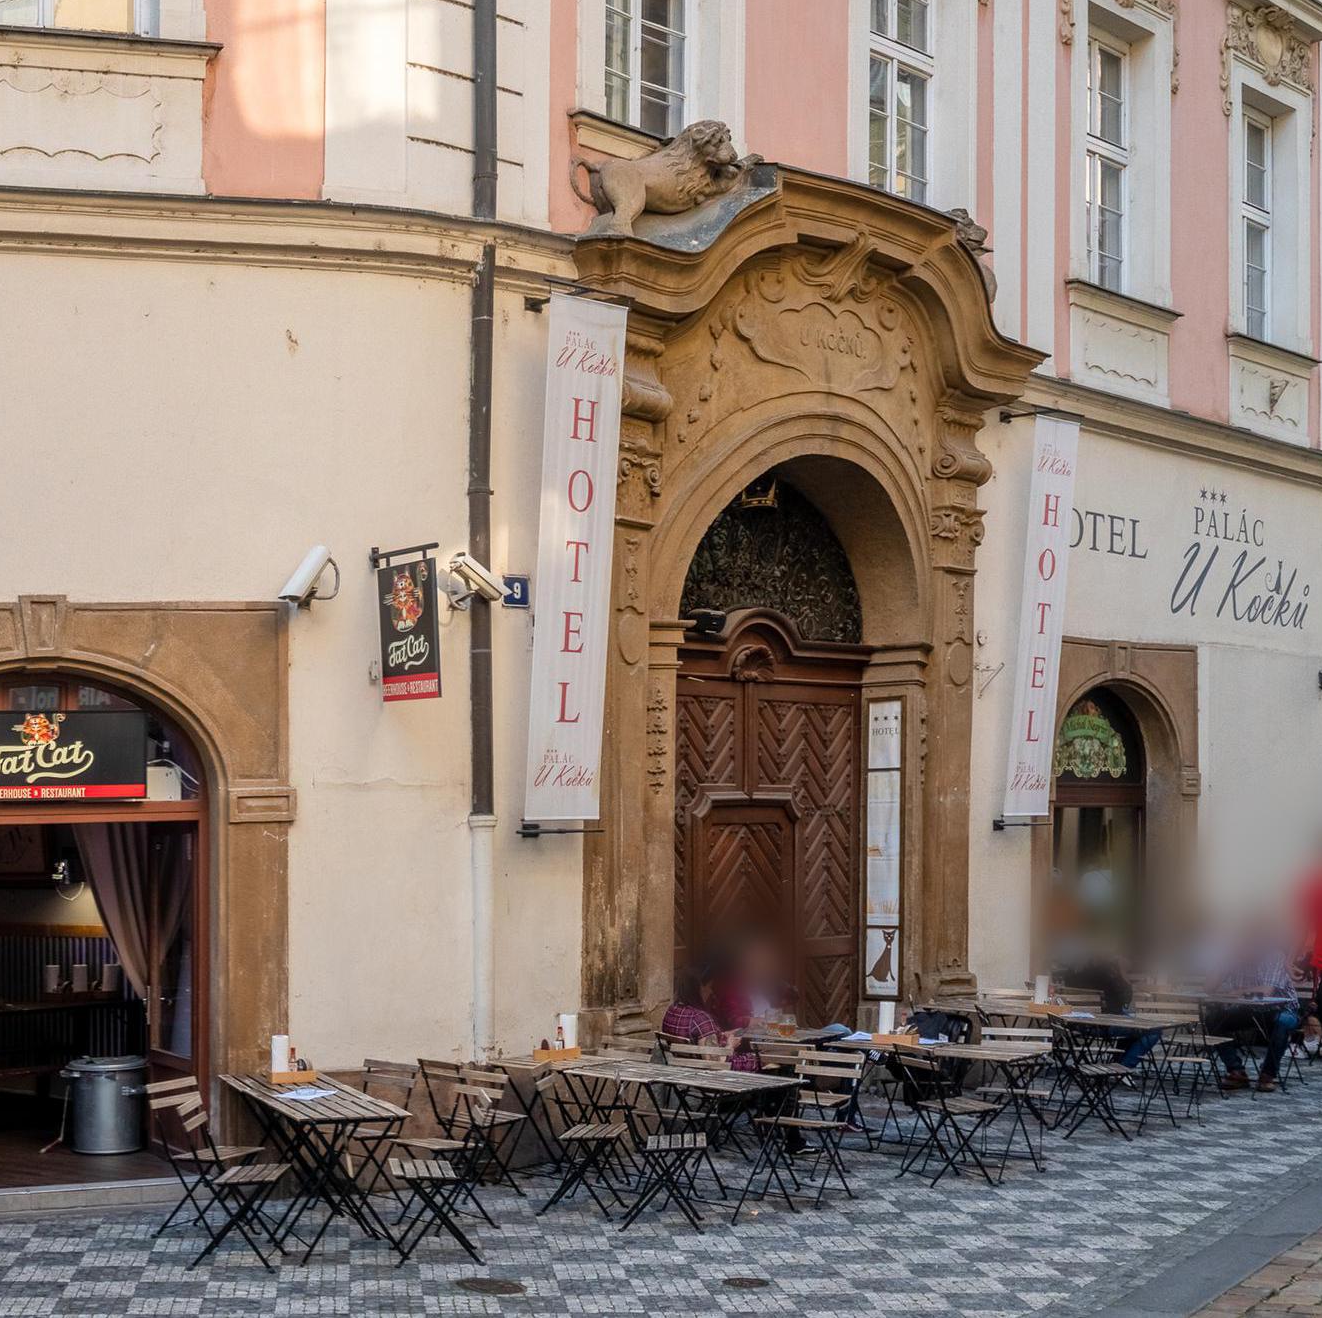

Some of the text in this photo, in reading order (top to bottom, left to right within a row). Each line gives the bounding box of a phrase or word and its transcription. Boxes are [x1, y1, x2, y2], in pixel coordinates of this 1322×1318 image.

[555, 346, 577, 369] U
[1193, 505, 1265, 548] PALÁC
[555, 397, 599, 724] HOTEL
[512, 581, 522, 600] 9
[1170, 541, 1311, 630] U Kočků
[1025, 493, 1061, 743] HOTEL
[387, 634, 427, 668] Fat Cat
[33, 740, 91, 773] Cat
[534, 764, 554, 788] U
[40, 787, 87, 799] RESTAURANT
